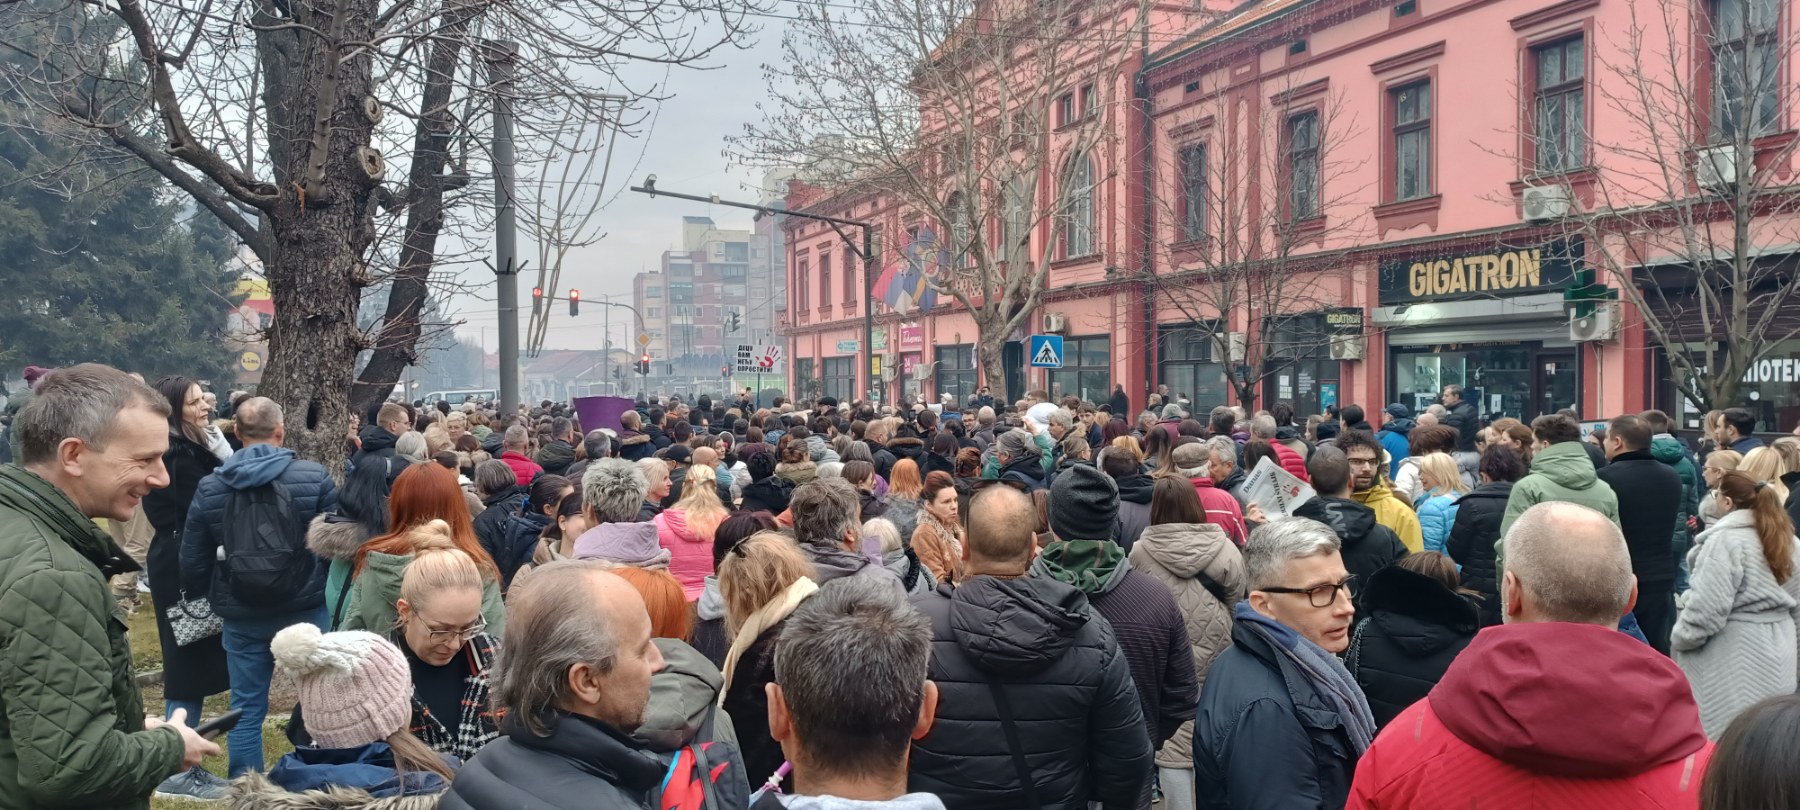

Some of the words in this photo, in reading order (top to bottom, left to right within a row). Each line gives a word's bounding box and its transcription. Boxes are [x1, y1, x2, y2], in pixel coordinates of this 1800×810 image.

[1409, 249, 1540, 297] GIGATRON
[1327, 314, 1361, 324] GIGATRON
[1243, 469, 1263, 493] Danas
